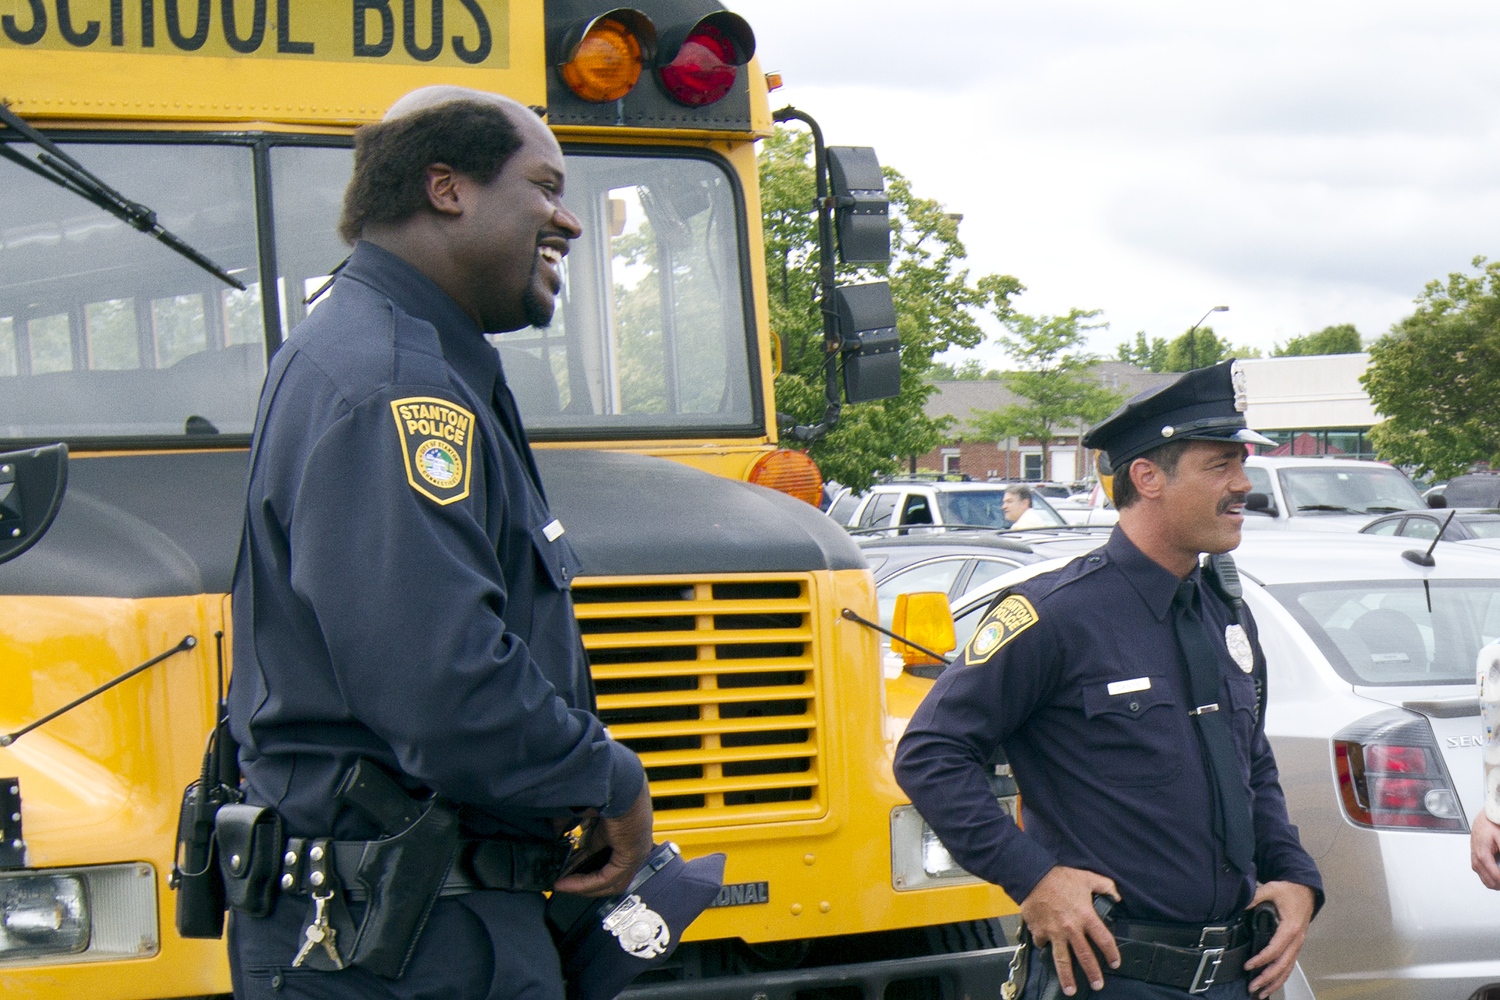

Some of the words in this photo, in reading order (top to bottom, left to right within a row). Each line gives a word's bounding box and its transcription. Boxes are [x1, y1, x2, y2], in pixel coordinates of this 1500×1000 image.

[399, 404, 469, 431] STANTON
[406, 419, 466, 446] POLICE
[1447, 735, 1483, 749] SEN
